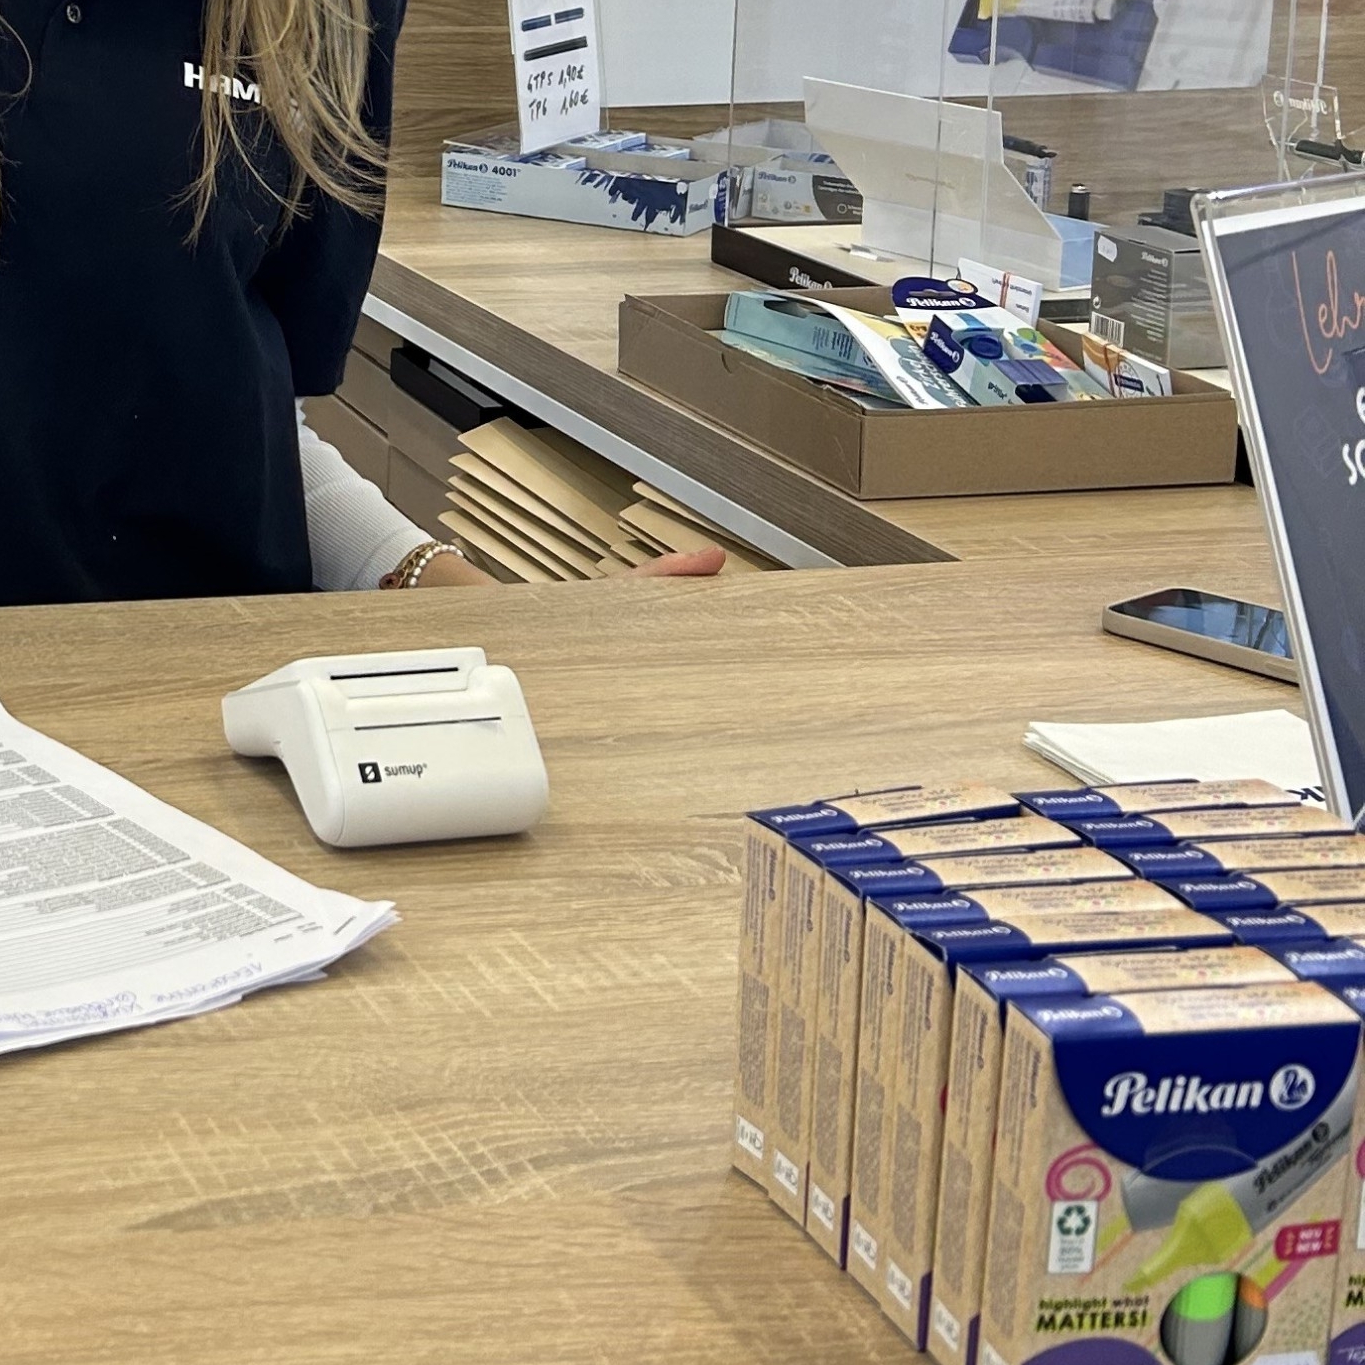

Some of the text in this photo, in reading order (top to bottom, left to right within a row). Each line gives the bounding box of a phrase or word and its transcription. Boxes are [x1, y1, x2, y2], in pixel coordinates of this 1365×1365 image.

[492, 166, 517, 177] 4001
[906, 297, 960, 308] Pelikan
[385, 763, 422, 778] sumup
[849, 866, 908, 879] Pelikan
[1226, 915, 1288, 927] Pelikan
[986, 969, 1050, 982] Pelikan
[1037, 1006, 1104, 1022] Pelikan
[1099, 1072, 1264, 1118] Pelikan
[1038, 1297, 1107, 1311] highlight
[1036, 1309, 1149, 1333] MATTERS!
